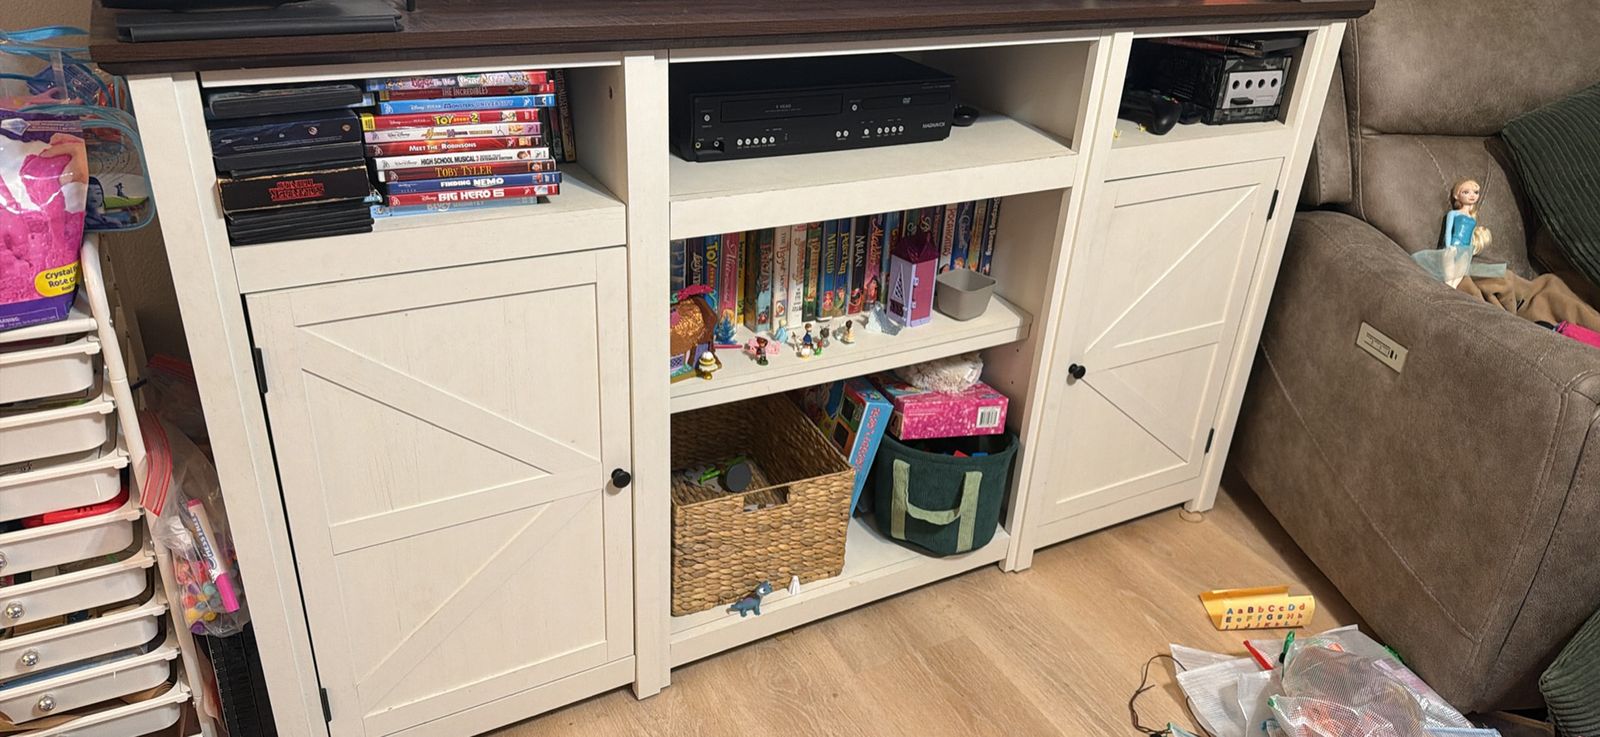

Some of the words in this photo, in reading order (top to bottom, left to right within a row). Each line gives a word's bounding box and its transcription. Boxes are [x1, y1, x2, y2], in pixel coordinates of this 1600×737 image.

[434, 114, 454, 126] TOY
[470, 112, 479, 123] 2
[435, 166, 459, 177] TOBY
[460, 165, 493, 176] TYLER
[440, 180, 471, 188] FINDING
[473, 177, 505, 187] NEMO
[438, 192, 458, 202] BIG
[460, 189, 491, 200] HERO
[493, 188, 505, 197] 6
[840, 232, 849, 255] Peter
[870, 218, 884, 266] Aladdin
[706, 241, 718, 268] TOY
[855, 235, 865, 268] MULAN
[45, 267, 72, 280] Crystal
